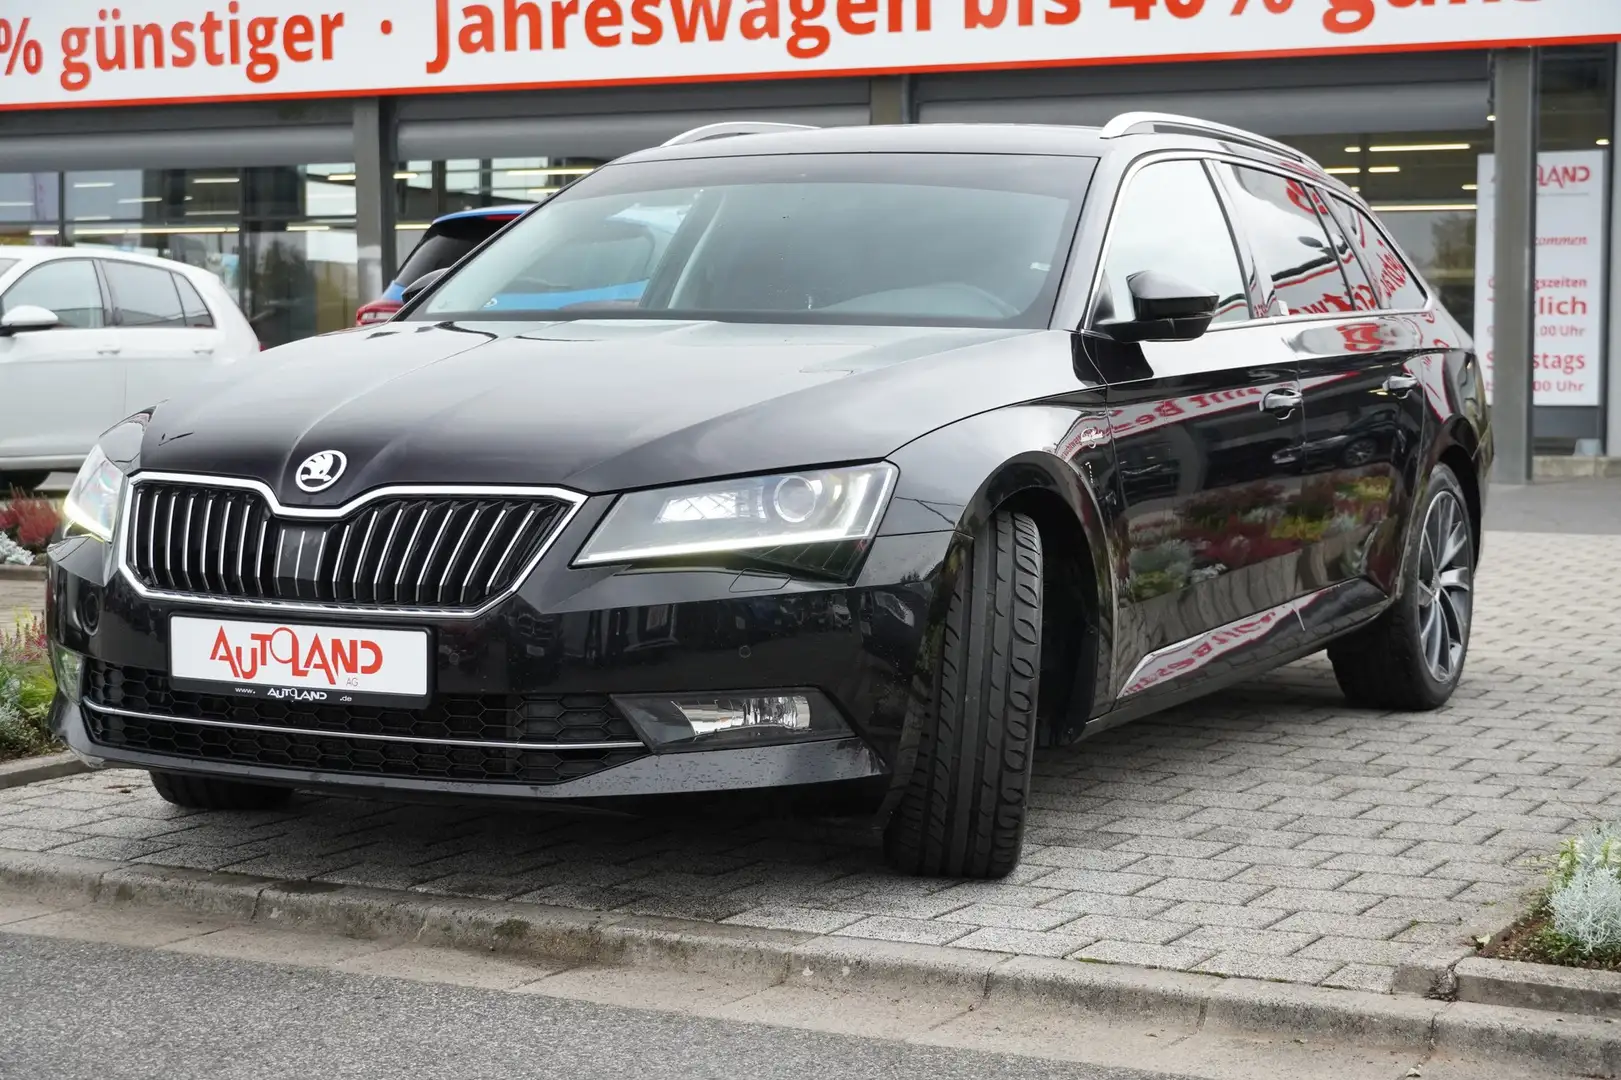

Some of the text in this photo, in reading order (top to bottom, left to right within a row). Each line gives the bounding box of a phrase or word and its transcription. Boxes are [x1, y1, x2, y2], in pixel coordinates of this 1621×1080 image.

[60, 0, 345, 91] günstiger
[426, 0, 932, 75] Jahreswagen
[345, 677, 360, 687] AG
